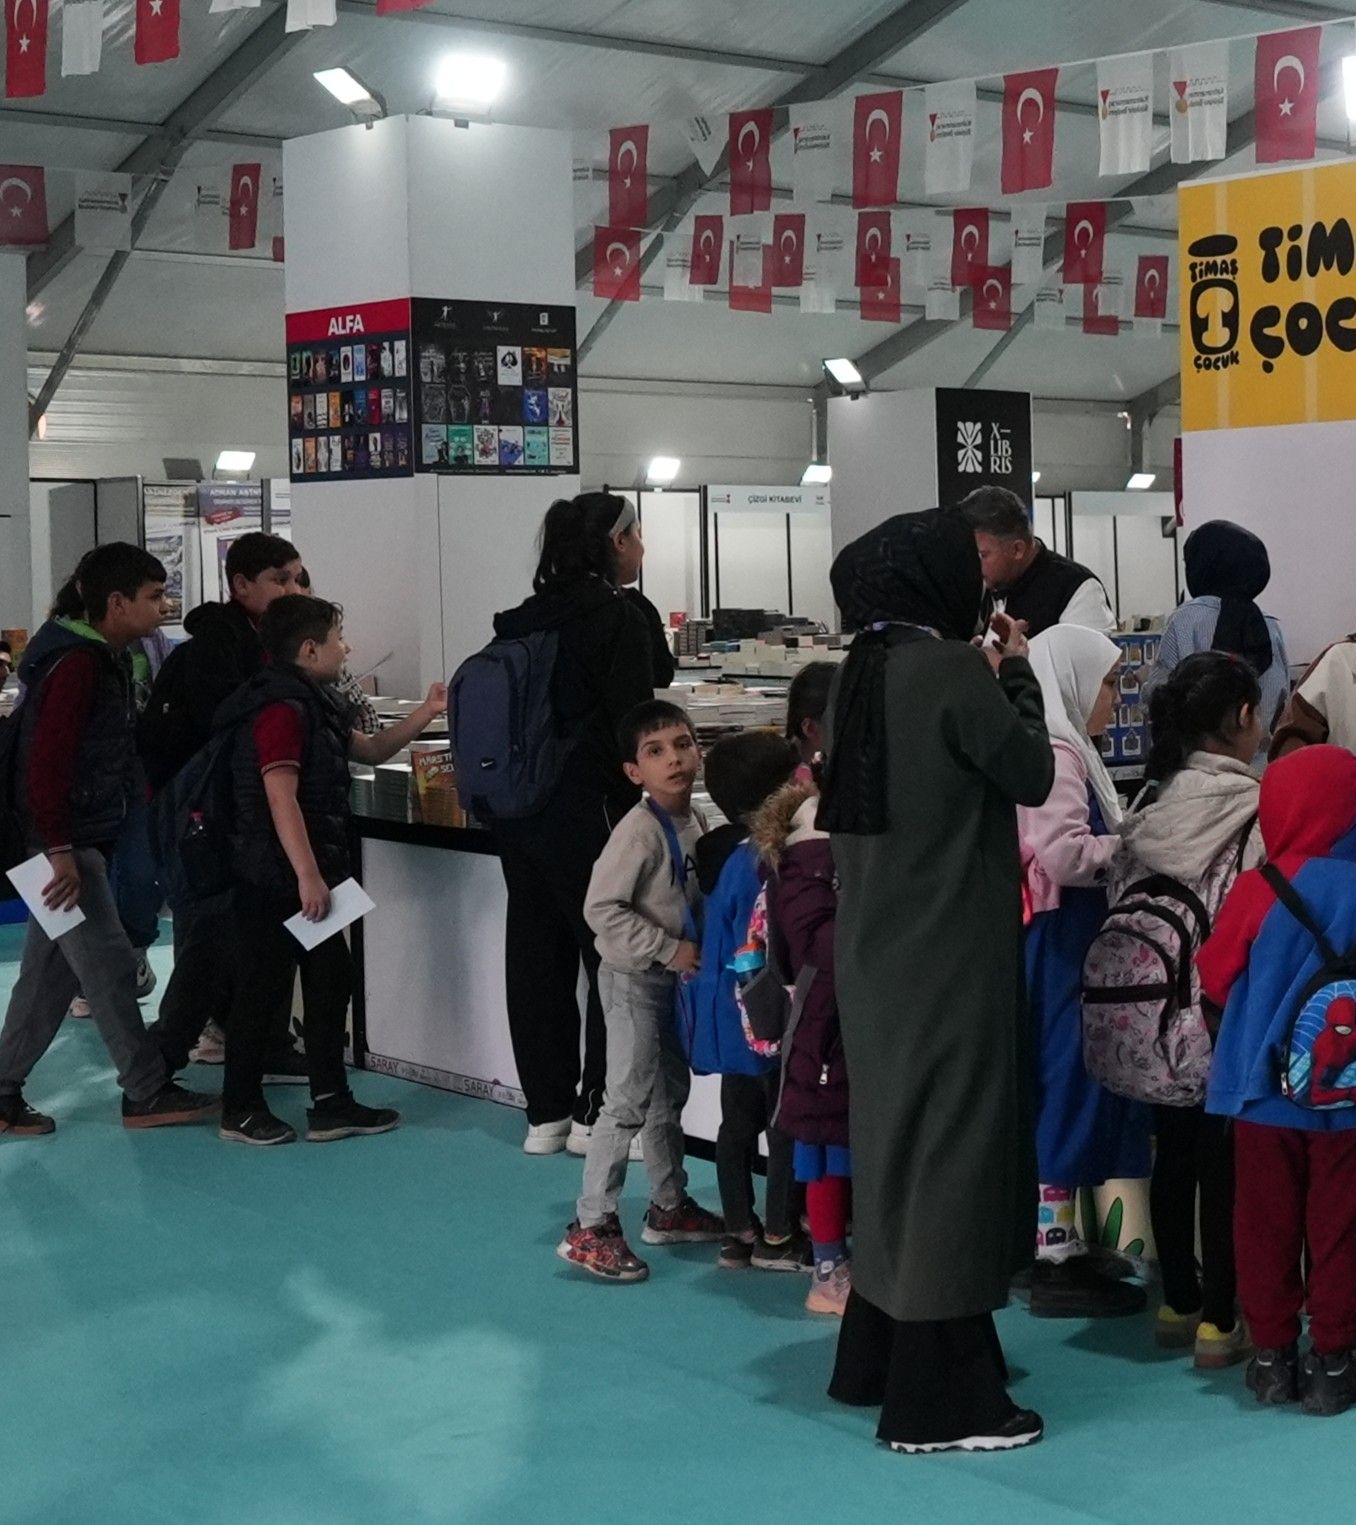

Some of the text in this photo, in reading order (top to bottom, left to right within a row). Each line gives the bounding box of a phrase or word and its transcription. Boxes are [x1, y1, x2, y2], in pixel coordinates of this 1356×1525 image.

[327, 313, 365, 336] ALFA
[1193, 350, 1240, 373] ÇOCUK
[369, 1056, 399, 1074] SARAY
[463, 1079, 494, 1097] SARAY
